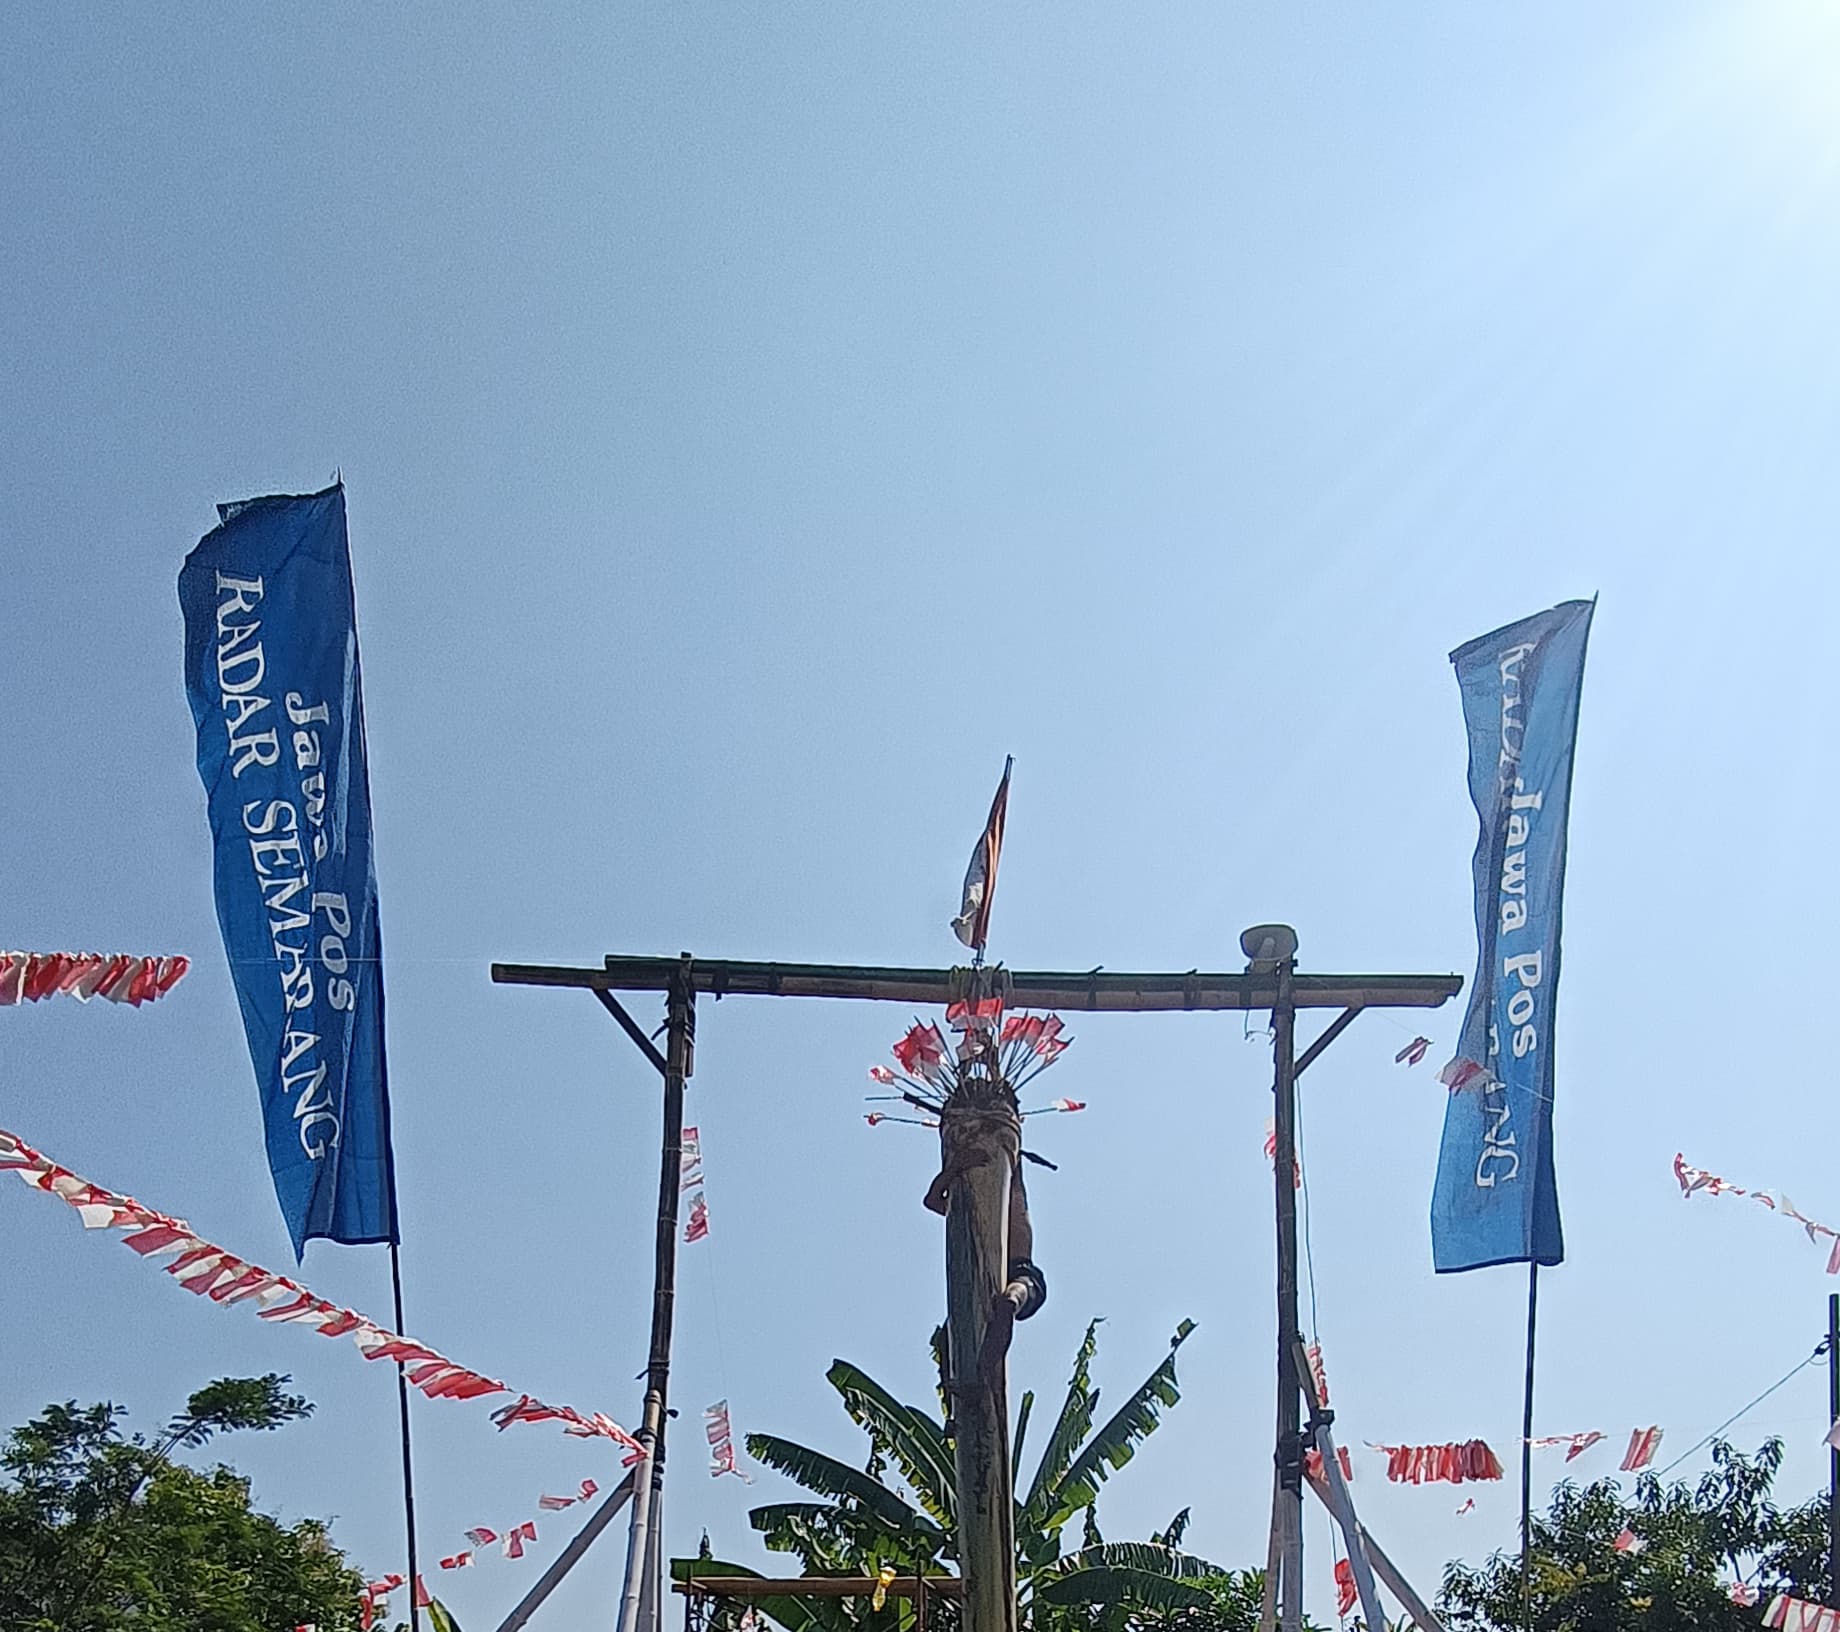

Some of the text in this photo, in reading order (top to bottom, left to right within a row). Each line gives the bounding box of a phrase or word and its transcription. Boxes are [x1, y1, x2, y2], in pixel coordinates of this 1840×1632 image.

[215, 568, 340, 1160] RADAR SEMARANG
[312, 891, 355, 1011] Pos
[1500, 776, 1543, 1058] Jawa Pos
